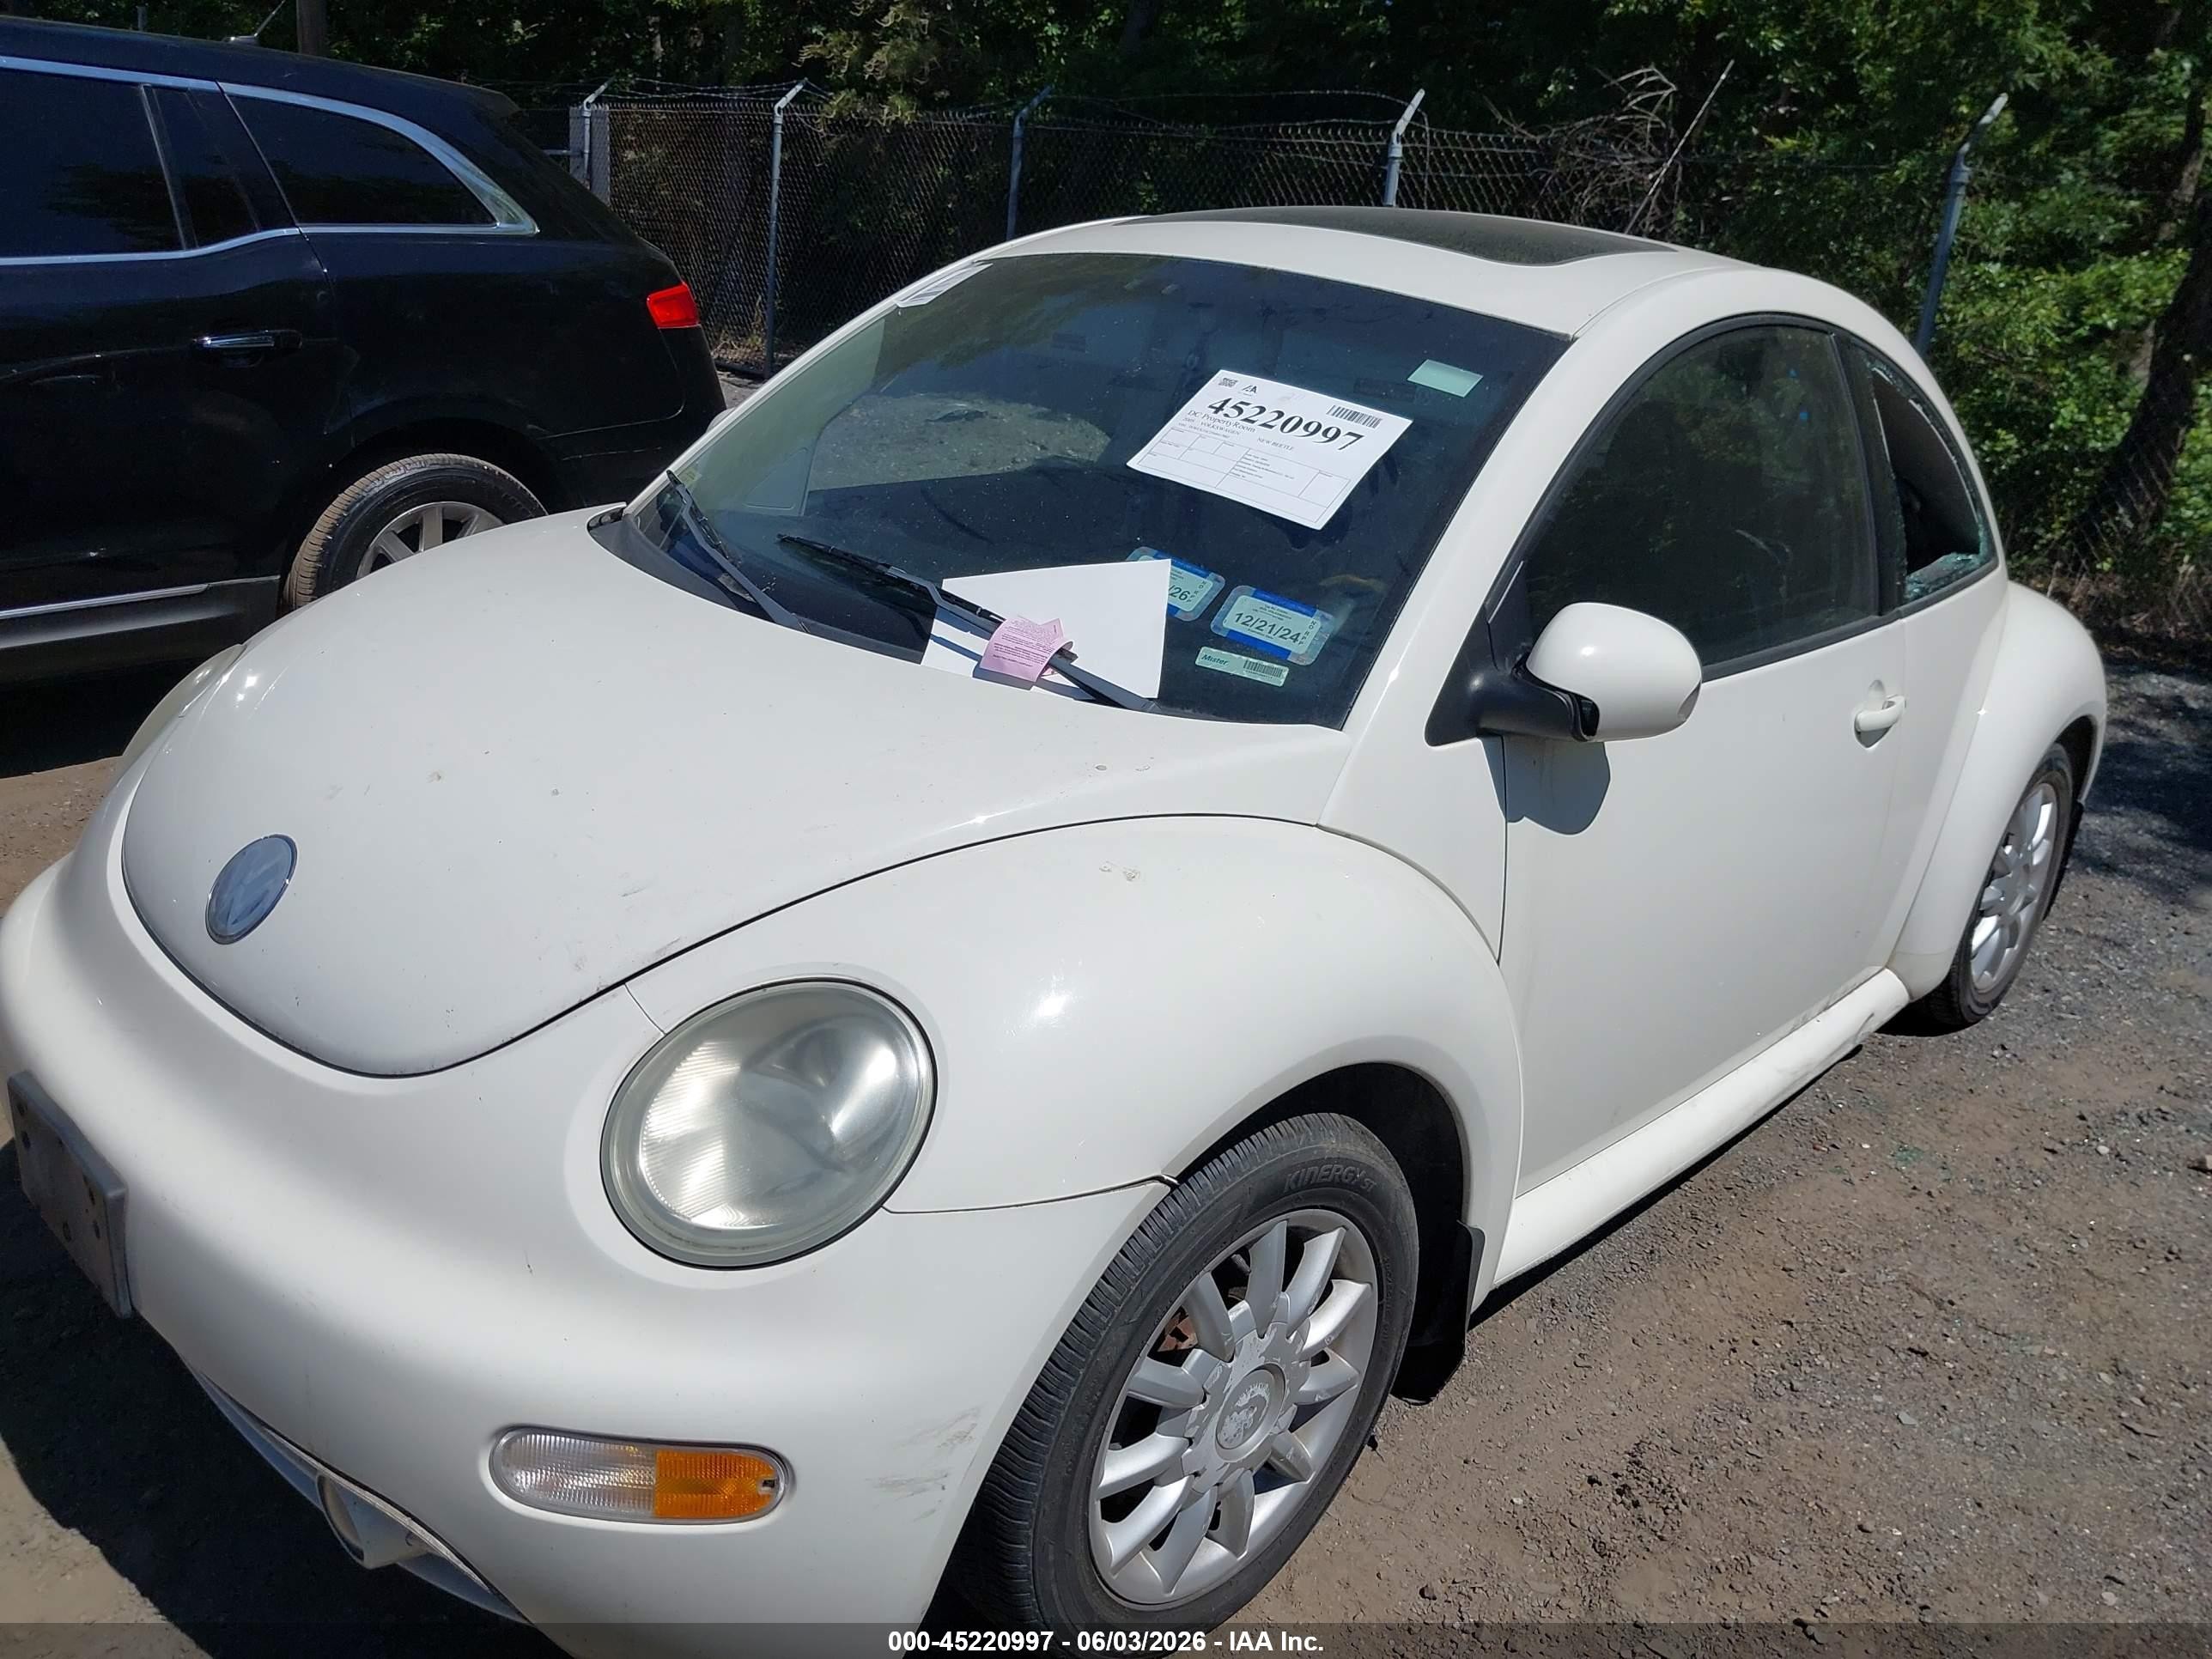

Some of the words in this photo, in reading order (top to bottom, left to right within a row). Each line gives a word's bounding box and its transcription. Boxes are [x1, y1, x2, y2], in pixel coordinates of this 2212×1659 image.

[1188, 410, 1201, 418] DC
[1207, 397, 1364, 451] 45220997
[1235, 612, 1301, 643] 12/21/24
[1202, 654, 1229, 665] Mister
